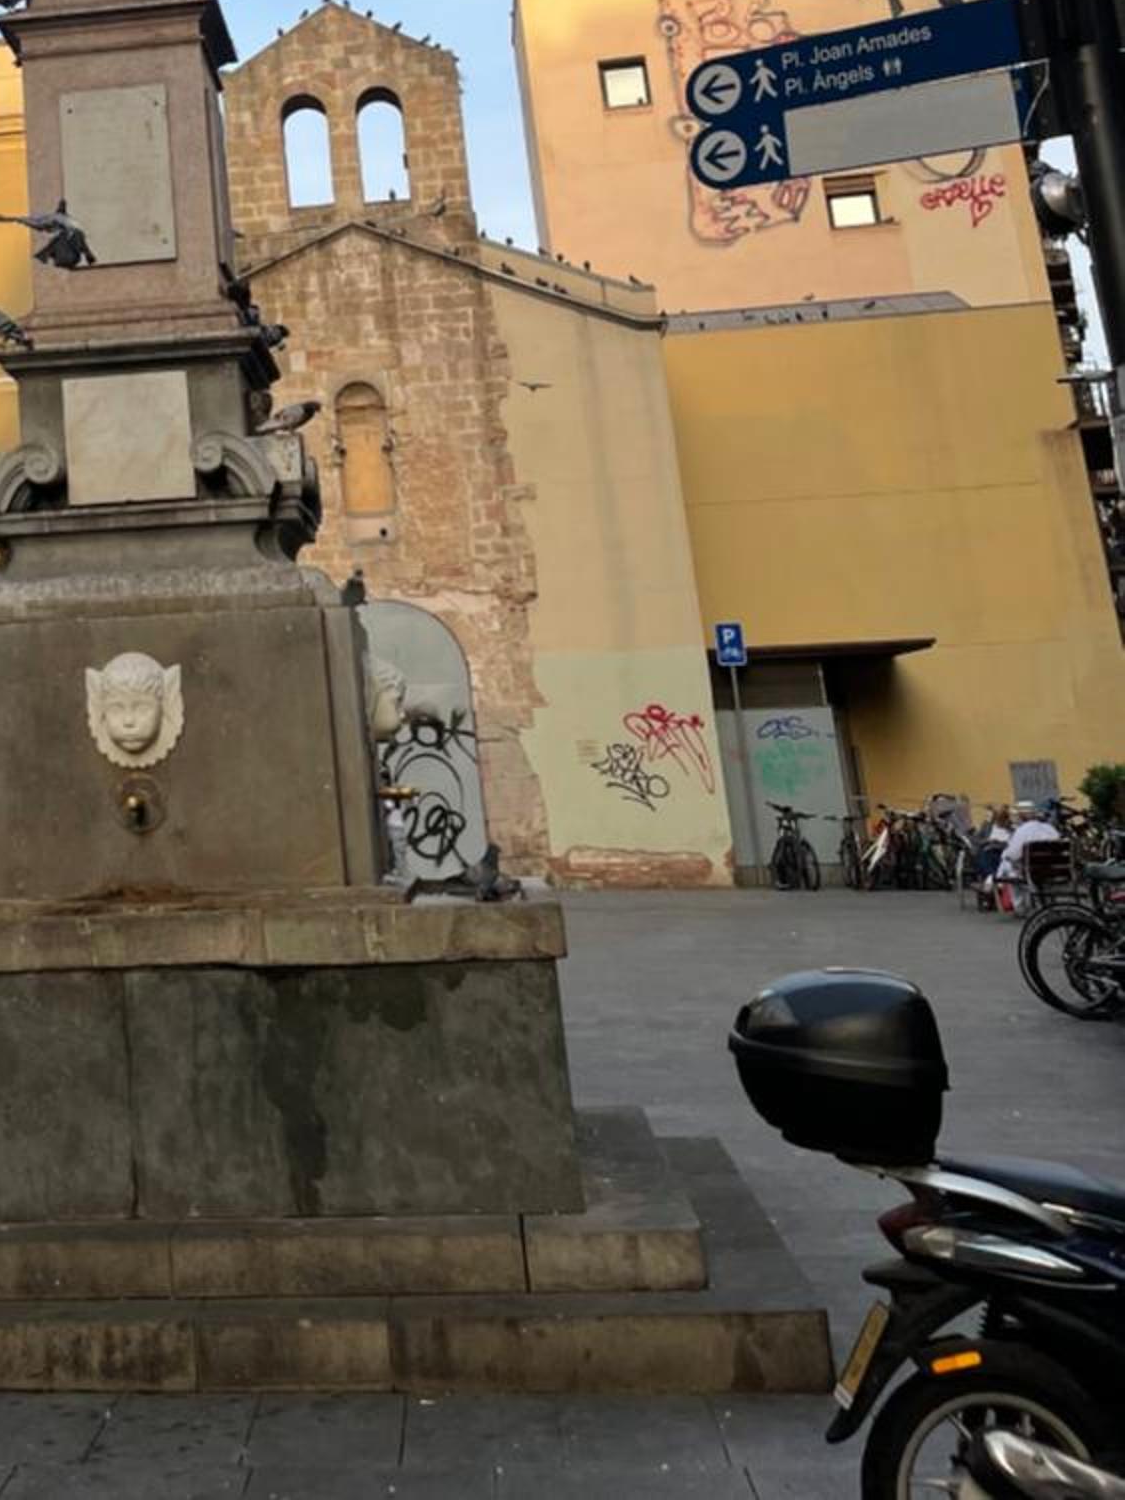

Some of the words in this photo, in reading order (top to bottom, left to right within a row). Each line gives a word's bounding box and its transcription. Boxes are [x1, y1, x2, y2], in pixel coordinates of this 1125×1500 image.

[781, 52, 805, 70] Pl.
[809, 42, 854, 65] Joan
[857, 25, 932, 54] Amades
[784, 77, 807, 96] Pl.
[722, 628, 735, 644] P
